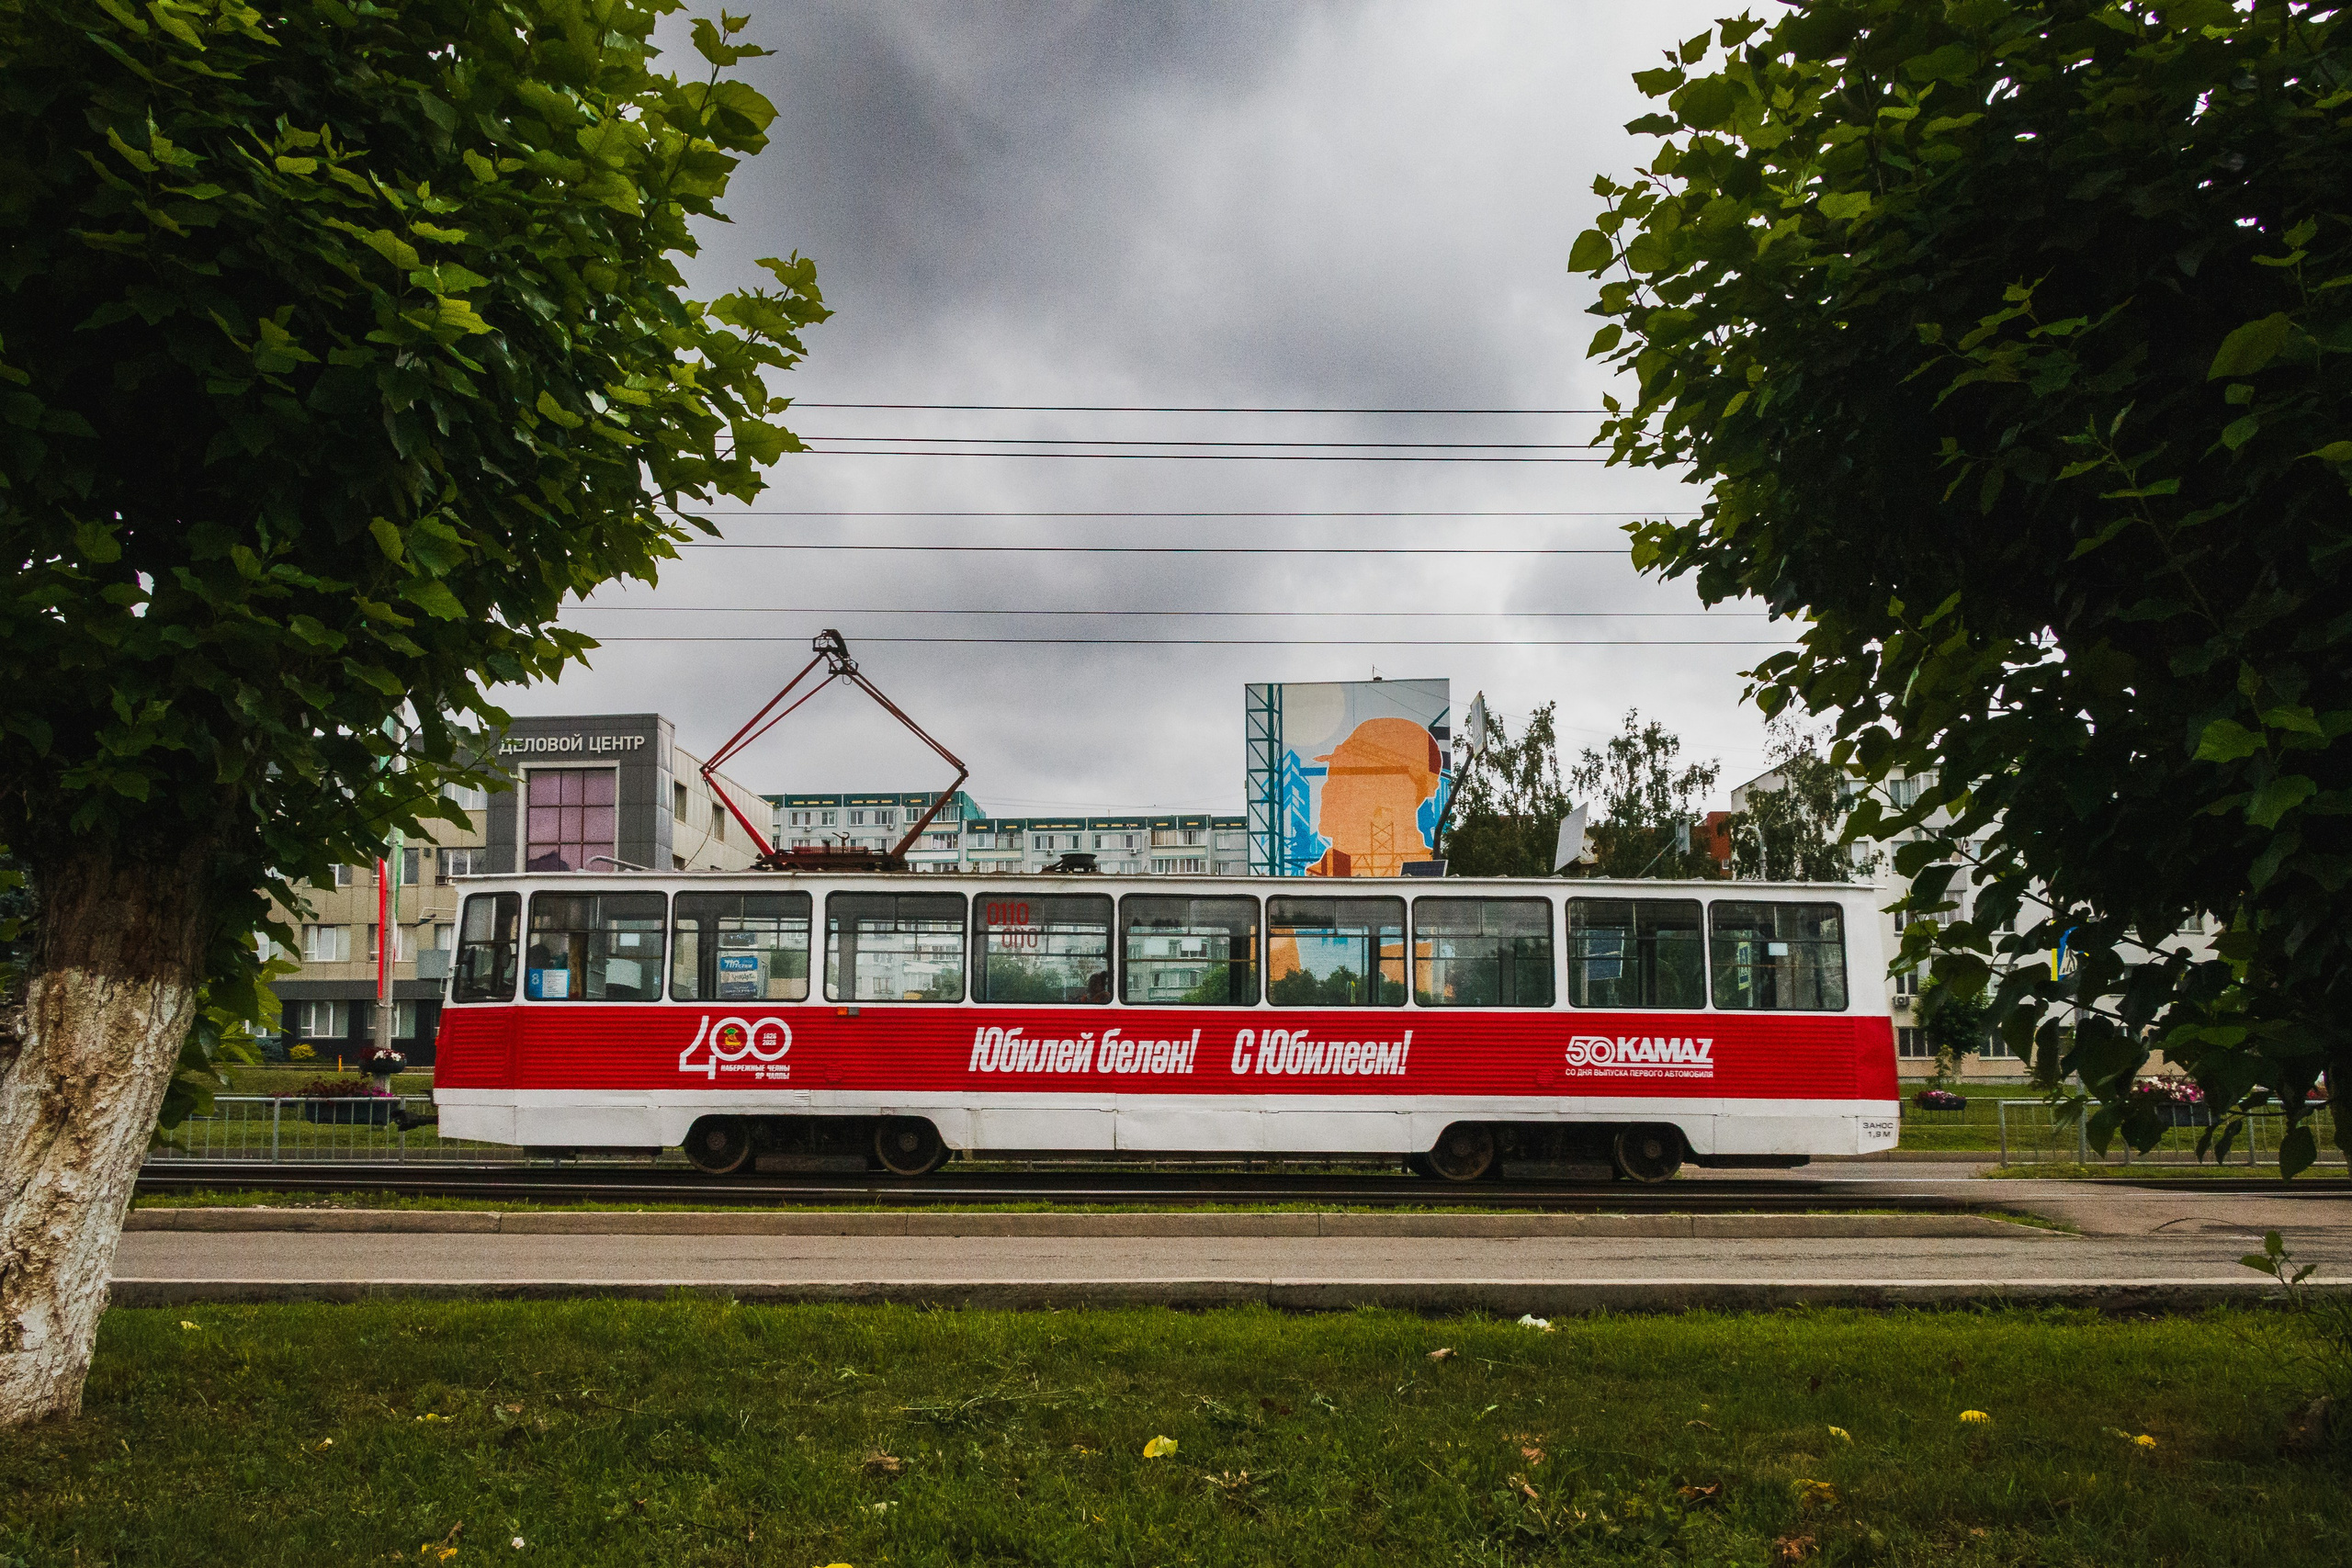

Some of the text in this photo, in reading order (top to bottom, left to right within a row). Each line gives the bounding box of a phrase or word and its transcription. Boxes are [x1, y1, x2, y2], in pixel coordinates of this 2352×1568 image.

[589, 736, 645, 754] ЦЕНТР
[986, 902, 1029, 926] 0110
[532, 973, 539, 986] 8
[678, 1015, 793, 1079] 400
[968, 1026, 1095, 1073] Юбилей
[1230, 1028, 1414, 1076] С Юбилеем!
[1616, 1036, 1713, 1064] KAMAZ
[720, 1064, 791, 1072] НАБЕРЕЖНЫЕ ЧЕЛНЫ
[1565, 1068, 1714, 1078] СО ДНЯ ВЫПУСКА ПЕРВОГО АВТОМОБИЛЯ
